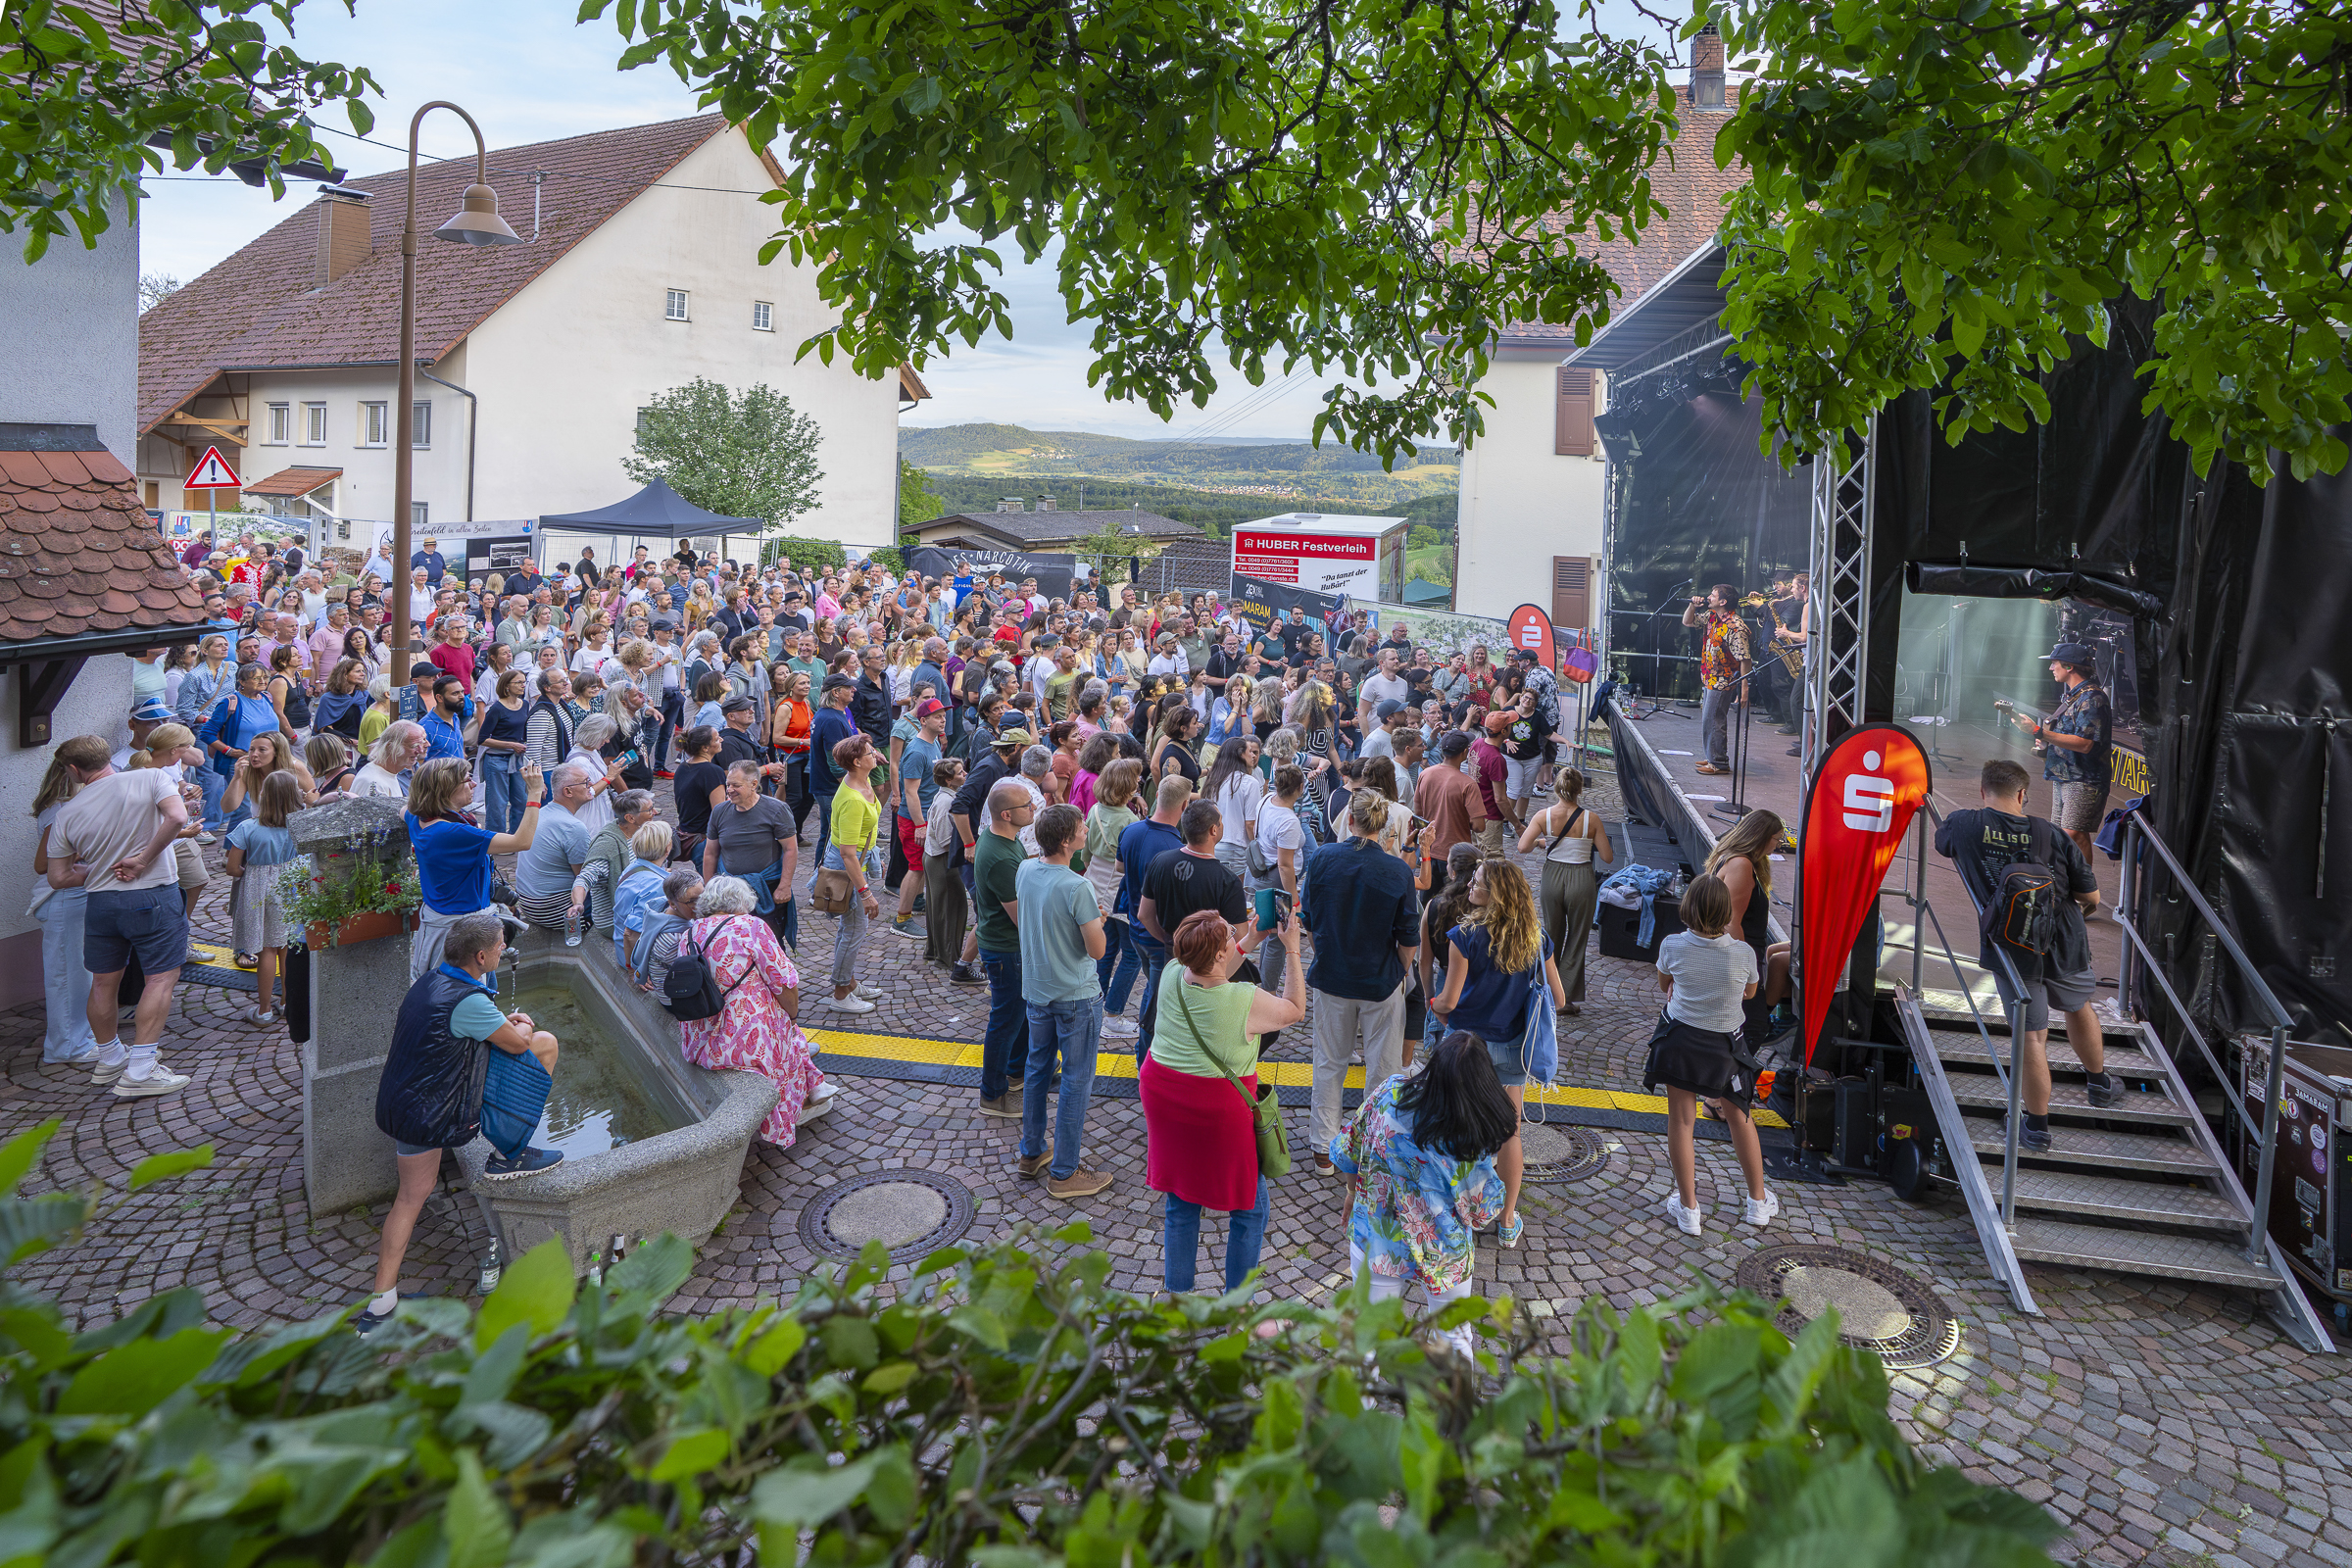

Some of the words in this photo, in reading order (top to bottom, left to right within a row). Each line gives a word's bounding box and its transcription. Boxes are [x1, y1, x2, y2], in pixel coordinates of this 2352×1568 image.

[1256, 539, 1299, 551] HUBER
[1302, 541, 1367, 554] Festverleih
[948, 552, 968, 570] LES
[976, 550, 1033, 575] NARCOTIK
[1336, 570, 1355, 580] tanzt
[2007, 833, 2018, 844] IS
